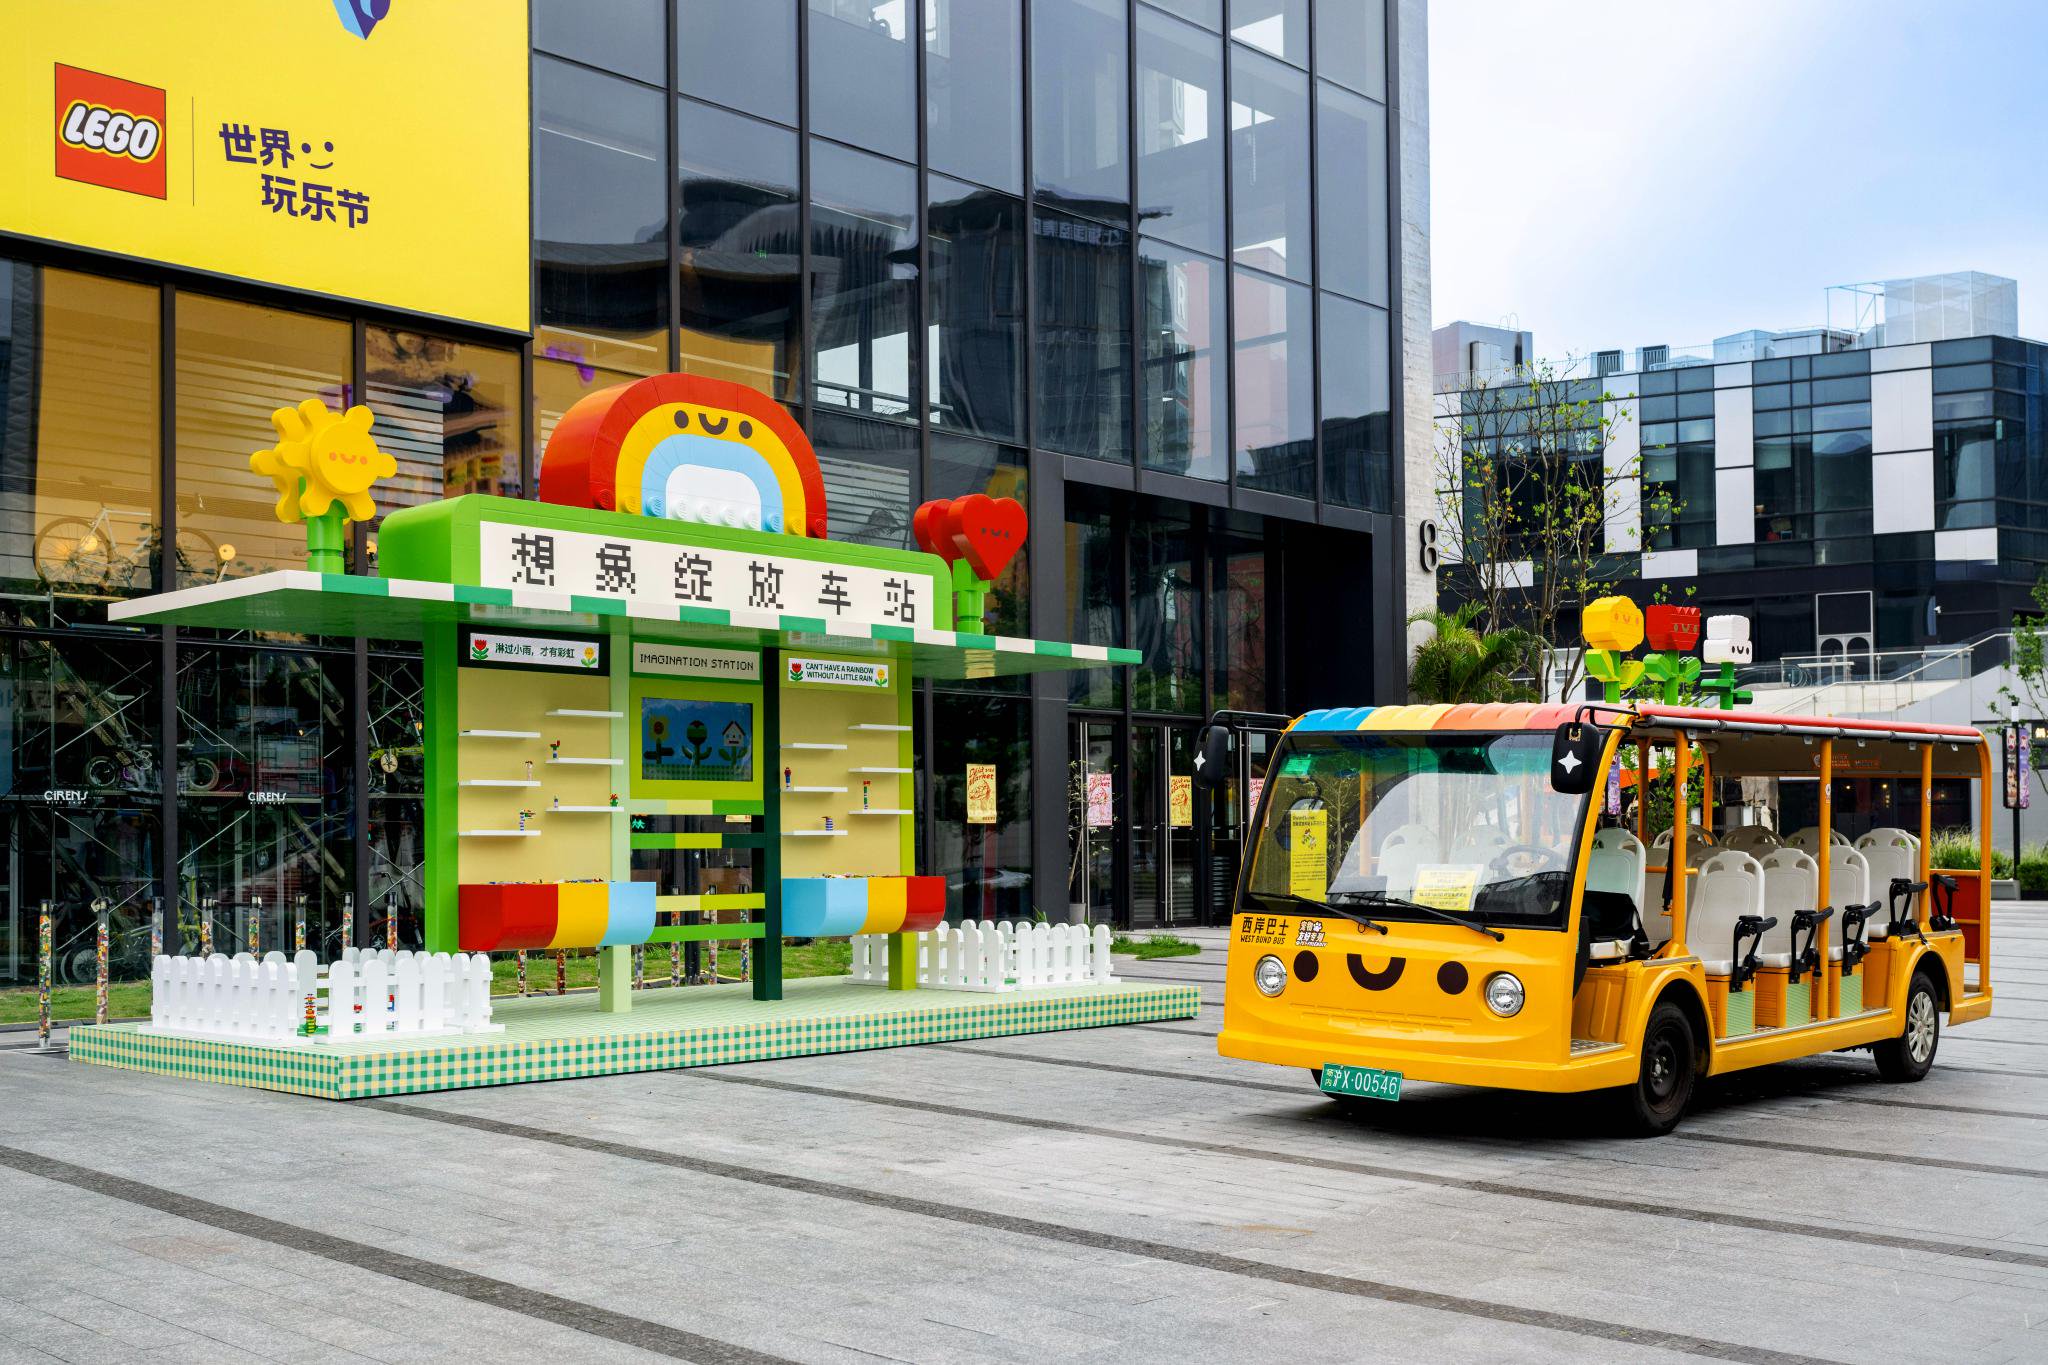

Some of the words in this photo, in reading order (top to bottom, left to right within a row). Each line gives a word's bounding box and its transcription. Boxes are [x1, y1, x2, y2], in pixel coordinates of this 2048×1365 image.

[63, 103, 160, 160] LEGO
[219, 123, 294, 168] 世界
[261, 173, 370, 228] 玩乐节
[1420, 519, 1439, 572] 8
[511, 533, 915, 623] 想象绽放车站
[639, 653, 708, 668] IMAGINATION
[711, 658, 754, 671] STATION
[807, 671, 834, 679] WITHOUT
[841, 673, 858, 681] LITTLE
[846, 666, 874, 675] RAINBOW
[1240, 935, 1254, 943] WEST
[1256, 936, 1271, 944] BUND
[1273, 937, 1285, 945] BUS
[1242, 916, 1289, 936] 西岸巴士
